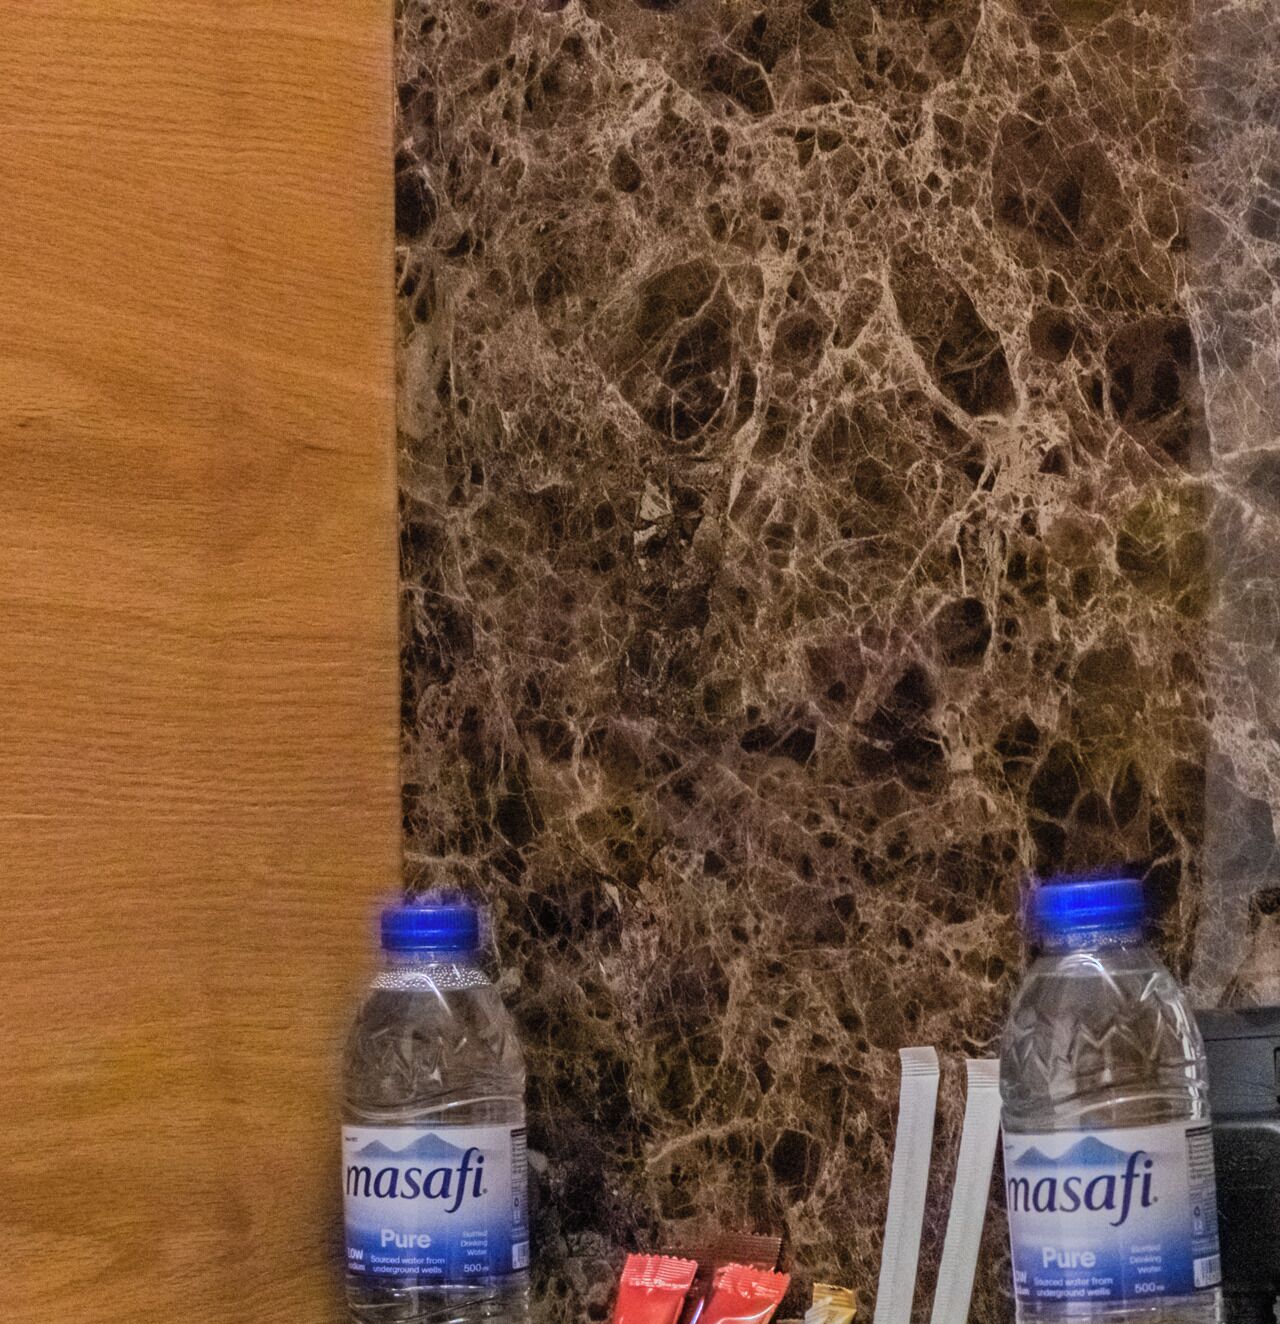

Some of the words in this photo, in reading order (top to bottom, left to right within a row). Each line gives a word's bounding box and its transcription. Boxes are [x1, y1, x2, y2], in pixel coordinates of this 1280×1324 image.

[346, 1147, 485, 1213] masafi
[1007, 1150, 1153, 1226] masafi
[381, 1229, 431, 1248] Pure
[370, 1255, 400, 1264] Sourced
[401, 1256, 424, 1264] water
[426, 1256, 446, 1264] from
[1042, 1247, 1097, 1268] Pure
[372, 1266, 420, 1274] underground
[421, 1266, 442, 1274] wells
[1065, 1277, 1089, 1286] water
[1091, 1276, 1114, 1285] from
[1087, 1287, 1111, 1296] wells
